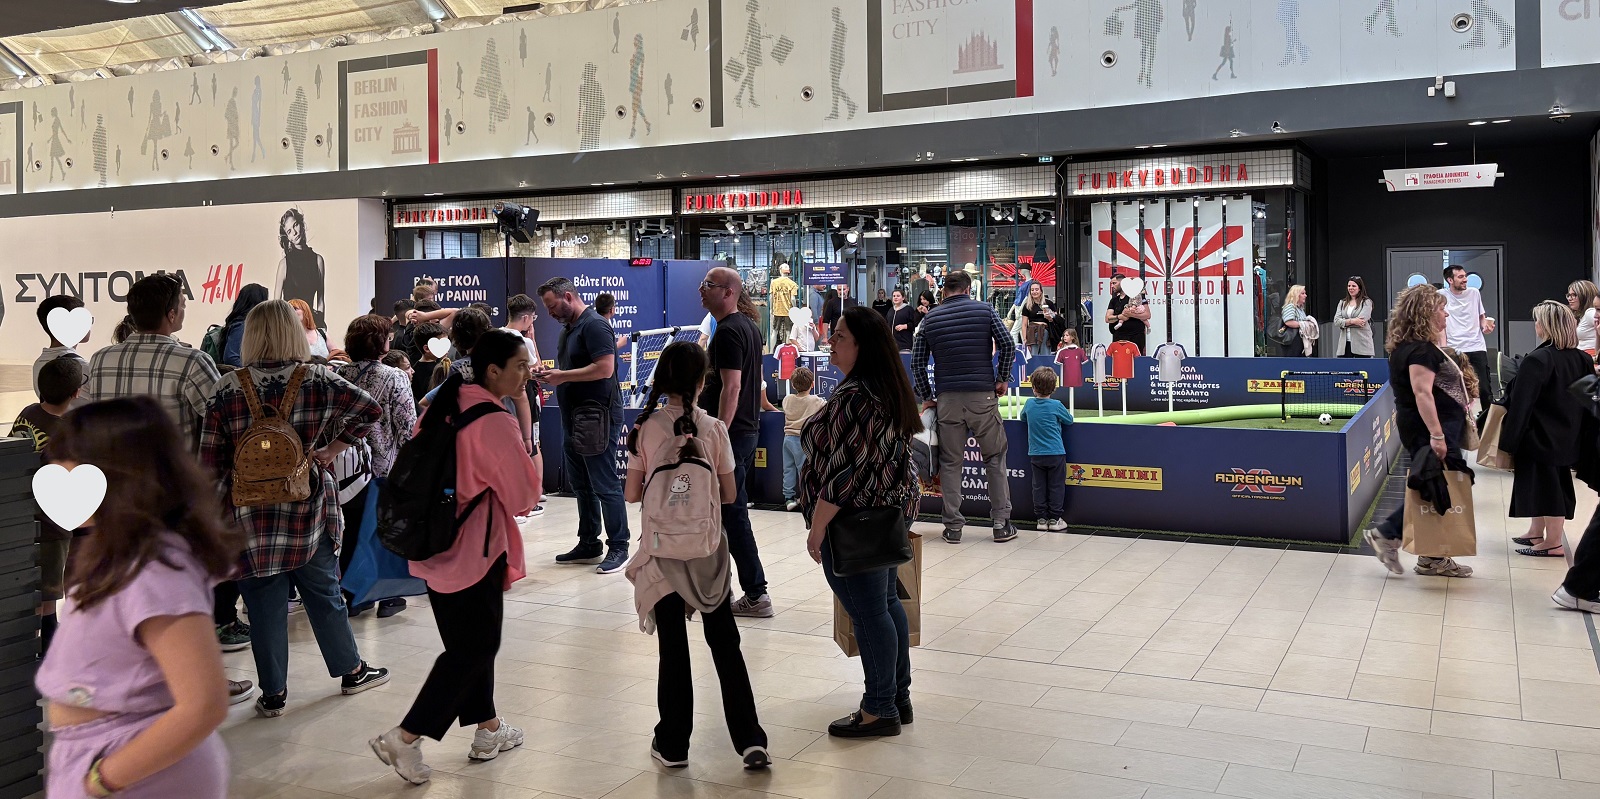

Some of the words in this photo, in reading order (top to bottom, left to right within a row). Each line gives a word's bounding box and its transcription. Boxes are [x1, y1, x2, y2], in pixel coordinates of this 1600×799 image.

[892, 18, 938, 39] CITY
[354, 77, 397, 95] BERLIN
[354, 100, 408, 118] FASHION
[354, 126, 382, 142] CITY
[1078, 164, 1248, 190] FUNKYBUDDHA
[686, 189, 803, 210] FUNKYBUDDHA
[397, 207, 488, 223] FUNKYBUDDHA
[15, 269, 195, 303] ΣΥΝΤΟΑ
[202, 264, 243, 304] H&M
[448, 275, 480, 287] ΓΚΟΛ
[574, 274, 600, 287] Βάλτε
[601, 277, 625, 287] ΓΚΟΛ
[446, 290, 487, 301] PANINI
[614, 303, 637, 317] άρτες
[1192, 380, 1220, 390] κάρτες
[1091, 467, 1158, 481] PANINI
[1215, 473, 1302, 486] ADRENALYN
[1420, 505, 1462, 515] peco
